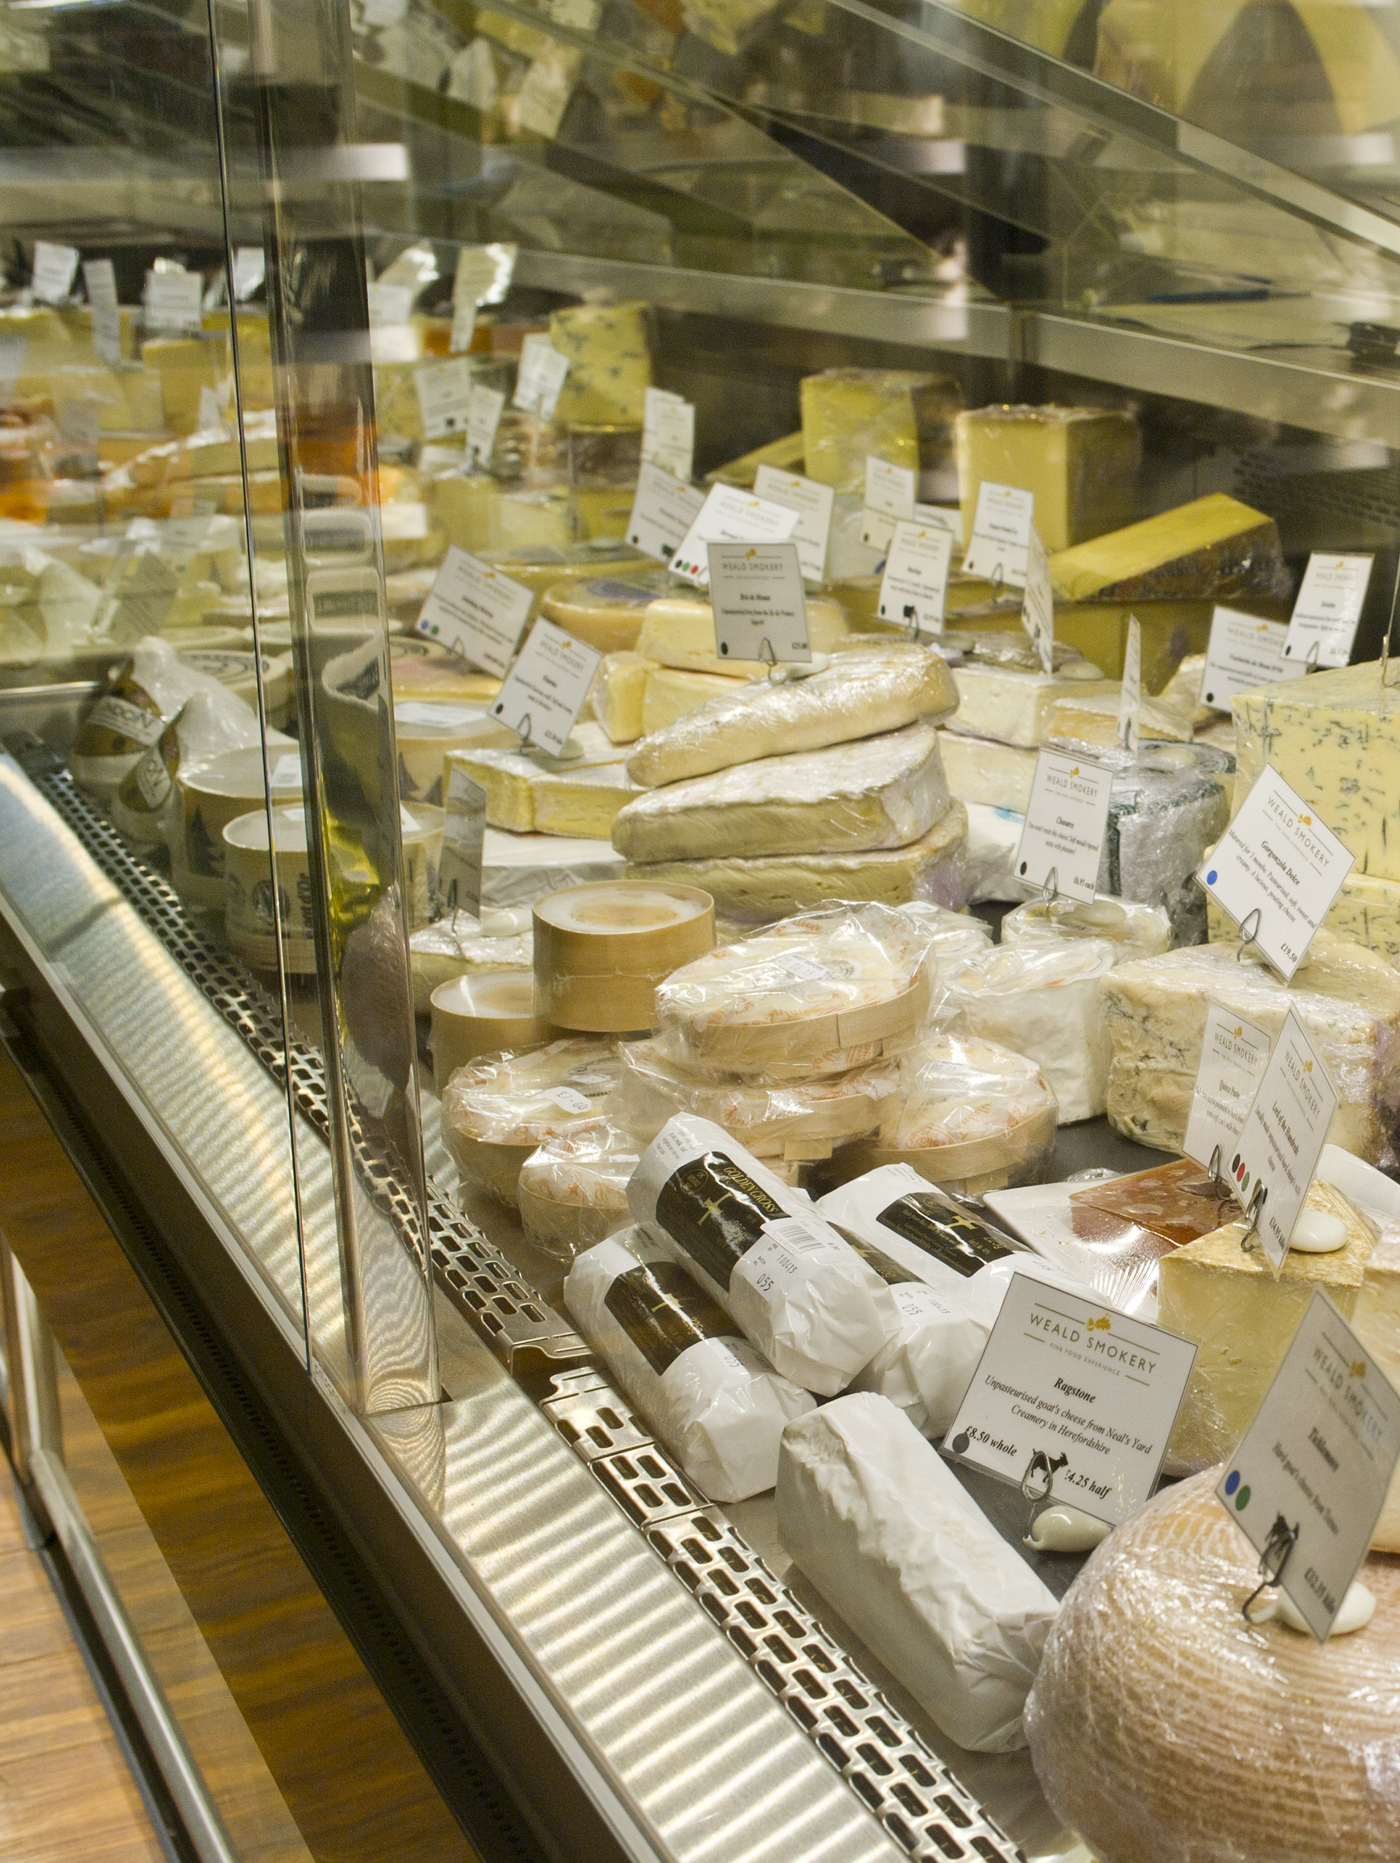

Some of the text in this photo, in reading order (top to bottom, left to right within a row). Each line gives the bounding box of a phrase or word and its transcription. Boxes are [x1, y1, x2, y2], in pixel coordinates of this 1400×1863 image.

[1267, 796, 1329, 867] WEALD SMOKERY
[1260, 840, 1300, 886] Gorgonzola Dolce
[1279, 942, 1297, 962] £19.50
[723, 1166, 779, 1213] GOLDEN CROSS
[1030, 1312, 1156, 1373] WEALD SMOKERY
[1049, 1341, 1120, 1376] FINE FOOD EXPERIENCE
[1053, 1377, 1096, 1403] Ragstone
[984, 1374, 1153, 1454] Unpasteurised goat's cheese from Neal's Yard
[1010, 1404, 1110, 1455] Creamery in Herefordshire
[961, 1425, 1017, 1456] £8.50 whole
[1087, 1480, 1112, 1499] half
